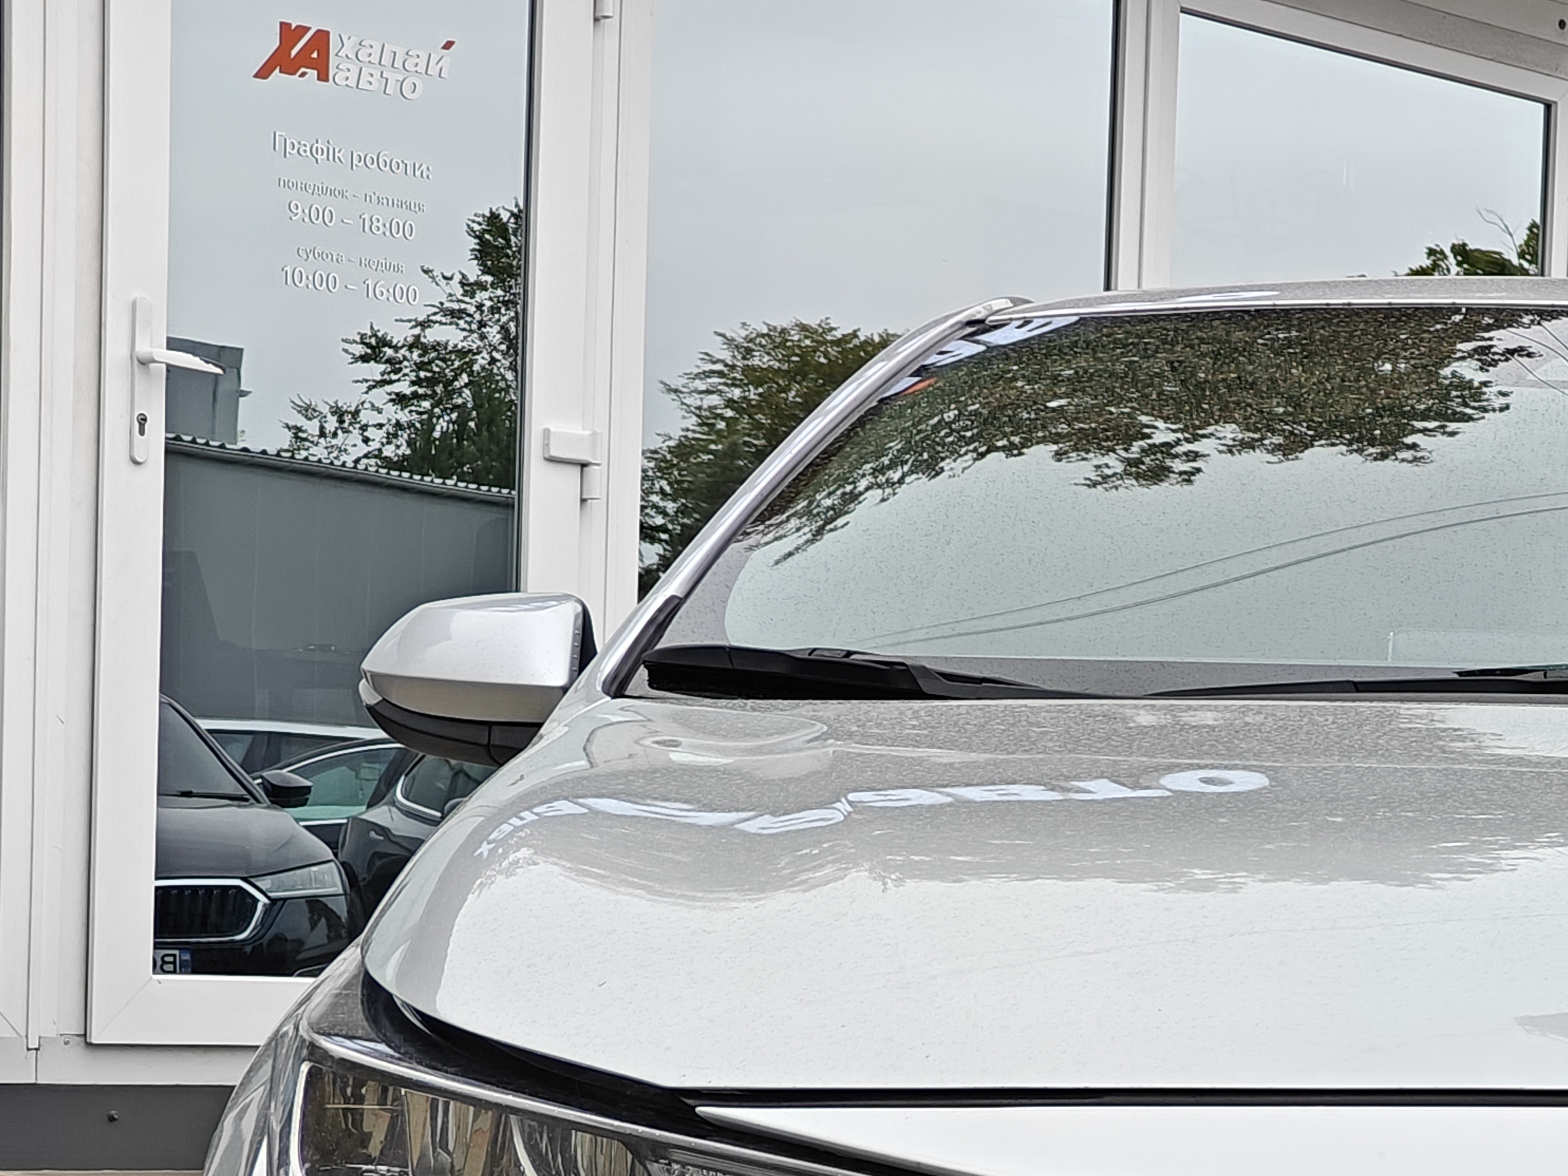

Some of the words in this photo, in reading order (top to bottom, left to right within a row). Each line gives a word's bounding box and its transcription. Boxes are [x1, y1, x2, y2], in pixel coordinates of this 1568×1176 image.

[335, 33, 456, 79] хапай
[333, 61, 424, 101] авто
[272, 130, 346, 165] Графік
[350, 149, 433, 181] роботи:
[277, 176, 351, 201] понеділок
[288, 200, 336, 228] 9:00
[359, 212, 416, 241] 18:00
[296, 244, 344, 265] субота
[358, 254, 405, 275] неділя
[281, 264, 340, 293] 10:00
[363, 277, 420, 306] 16:00
